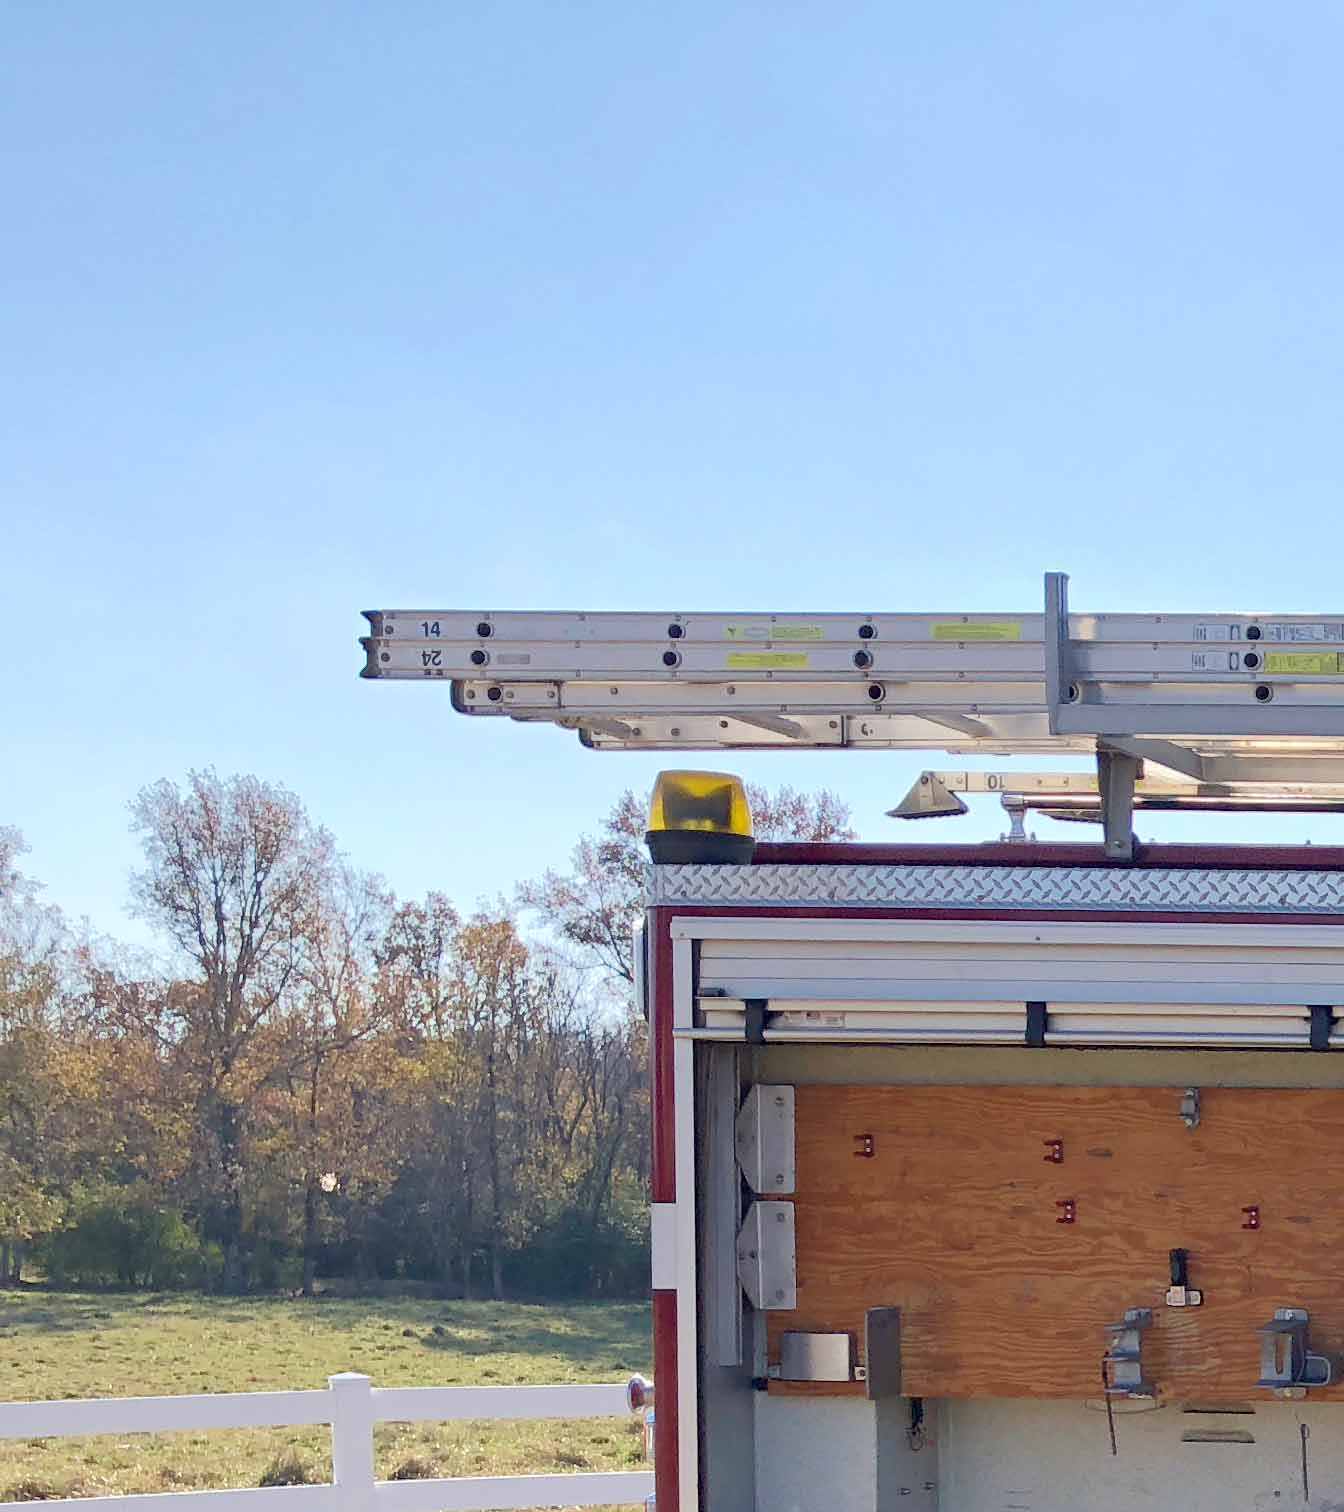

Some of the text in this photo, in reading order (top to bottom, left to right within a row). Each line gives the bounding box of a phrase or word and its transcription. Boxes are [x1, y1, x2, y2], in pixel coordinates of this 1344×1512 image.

[422, 622, 440, 636] 14
[422, 651, 441, 666] 24
[988, 775, 1005, 789] 10
